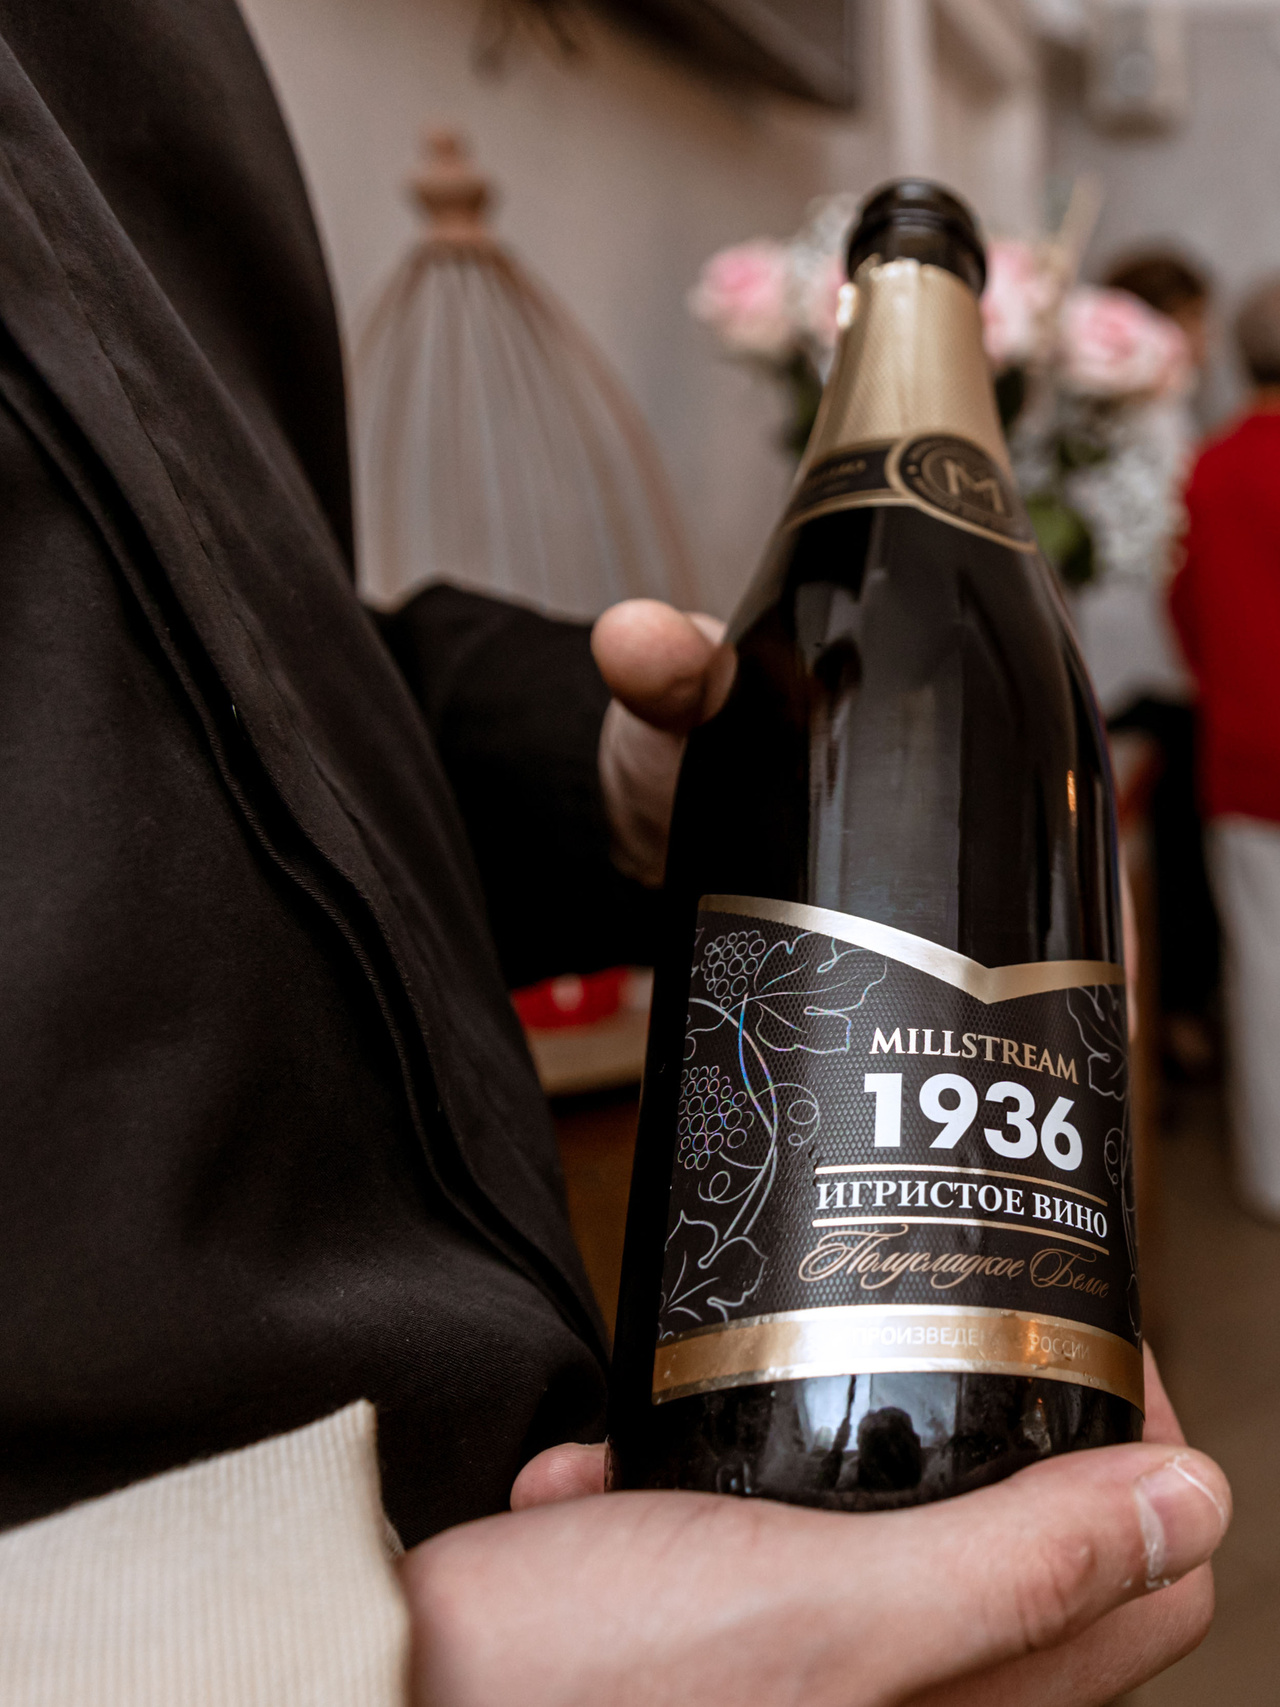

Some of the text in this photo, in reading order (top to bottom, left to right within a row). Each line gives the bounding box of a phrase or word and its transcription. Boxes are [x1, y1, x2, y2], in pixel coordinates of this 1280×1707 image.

[868, 1027, 1080, 1085] MILLSTREAM
[863, 1072, 1083, 1171] 1936
[815, 1179, 1108, 1239] ИГРИСТОЕ ВИНО
[798, 1223, 1109, 1298] Полусладкое Белое
[853, 1326, 1090, 1360] ПРОИЗВЕДЕ РОССИИ
